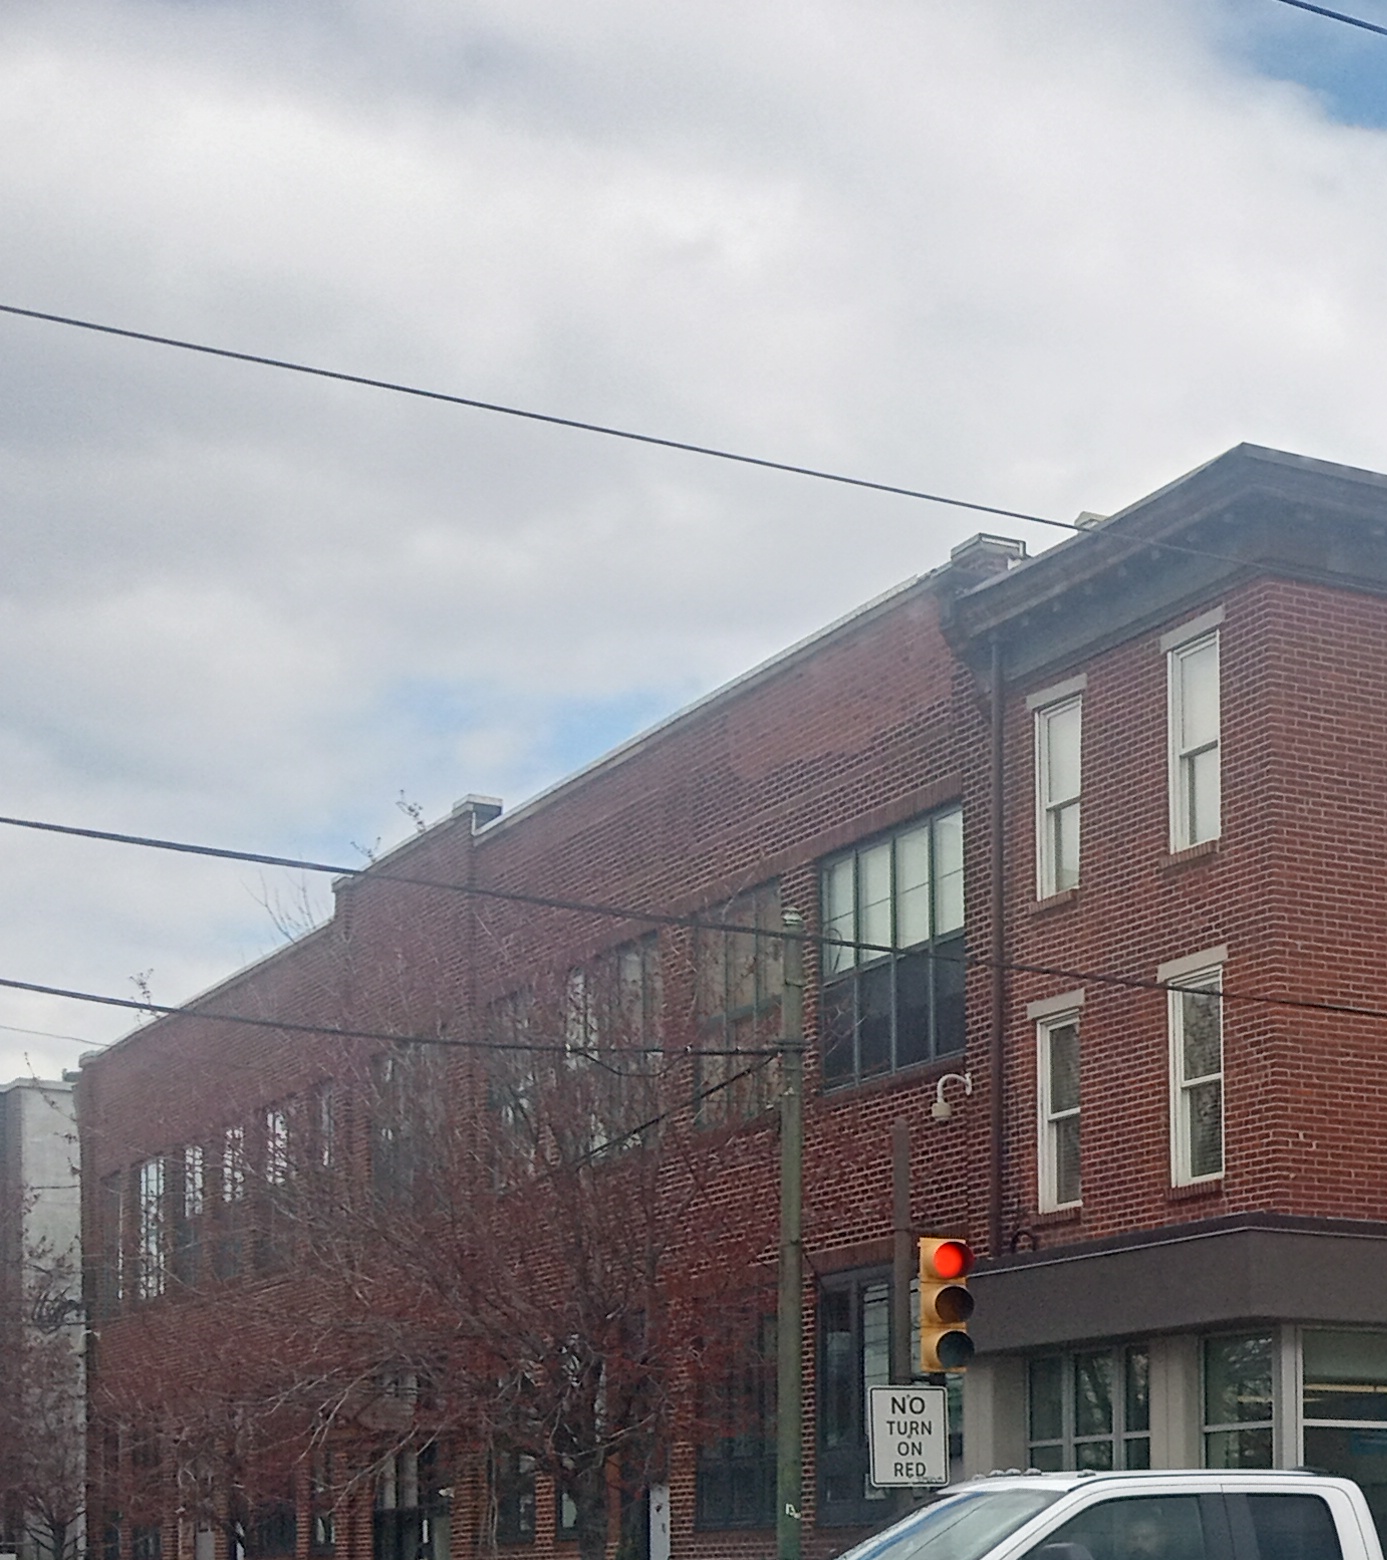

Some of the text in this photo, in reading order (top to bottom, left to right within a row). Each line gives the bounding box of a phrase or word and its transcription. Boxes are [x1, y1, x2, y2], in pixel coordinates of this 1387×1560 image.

[891, 1395, 926, 1415] NO
[886, 1420, 932, 1435] TURN
[897, 1441, 922, 1456] ON
[894, 1462, 926, 1477] RED
